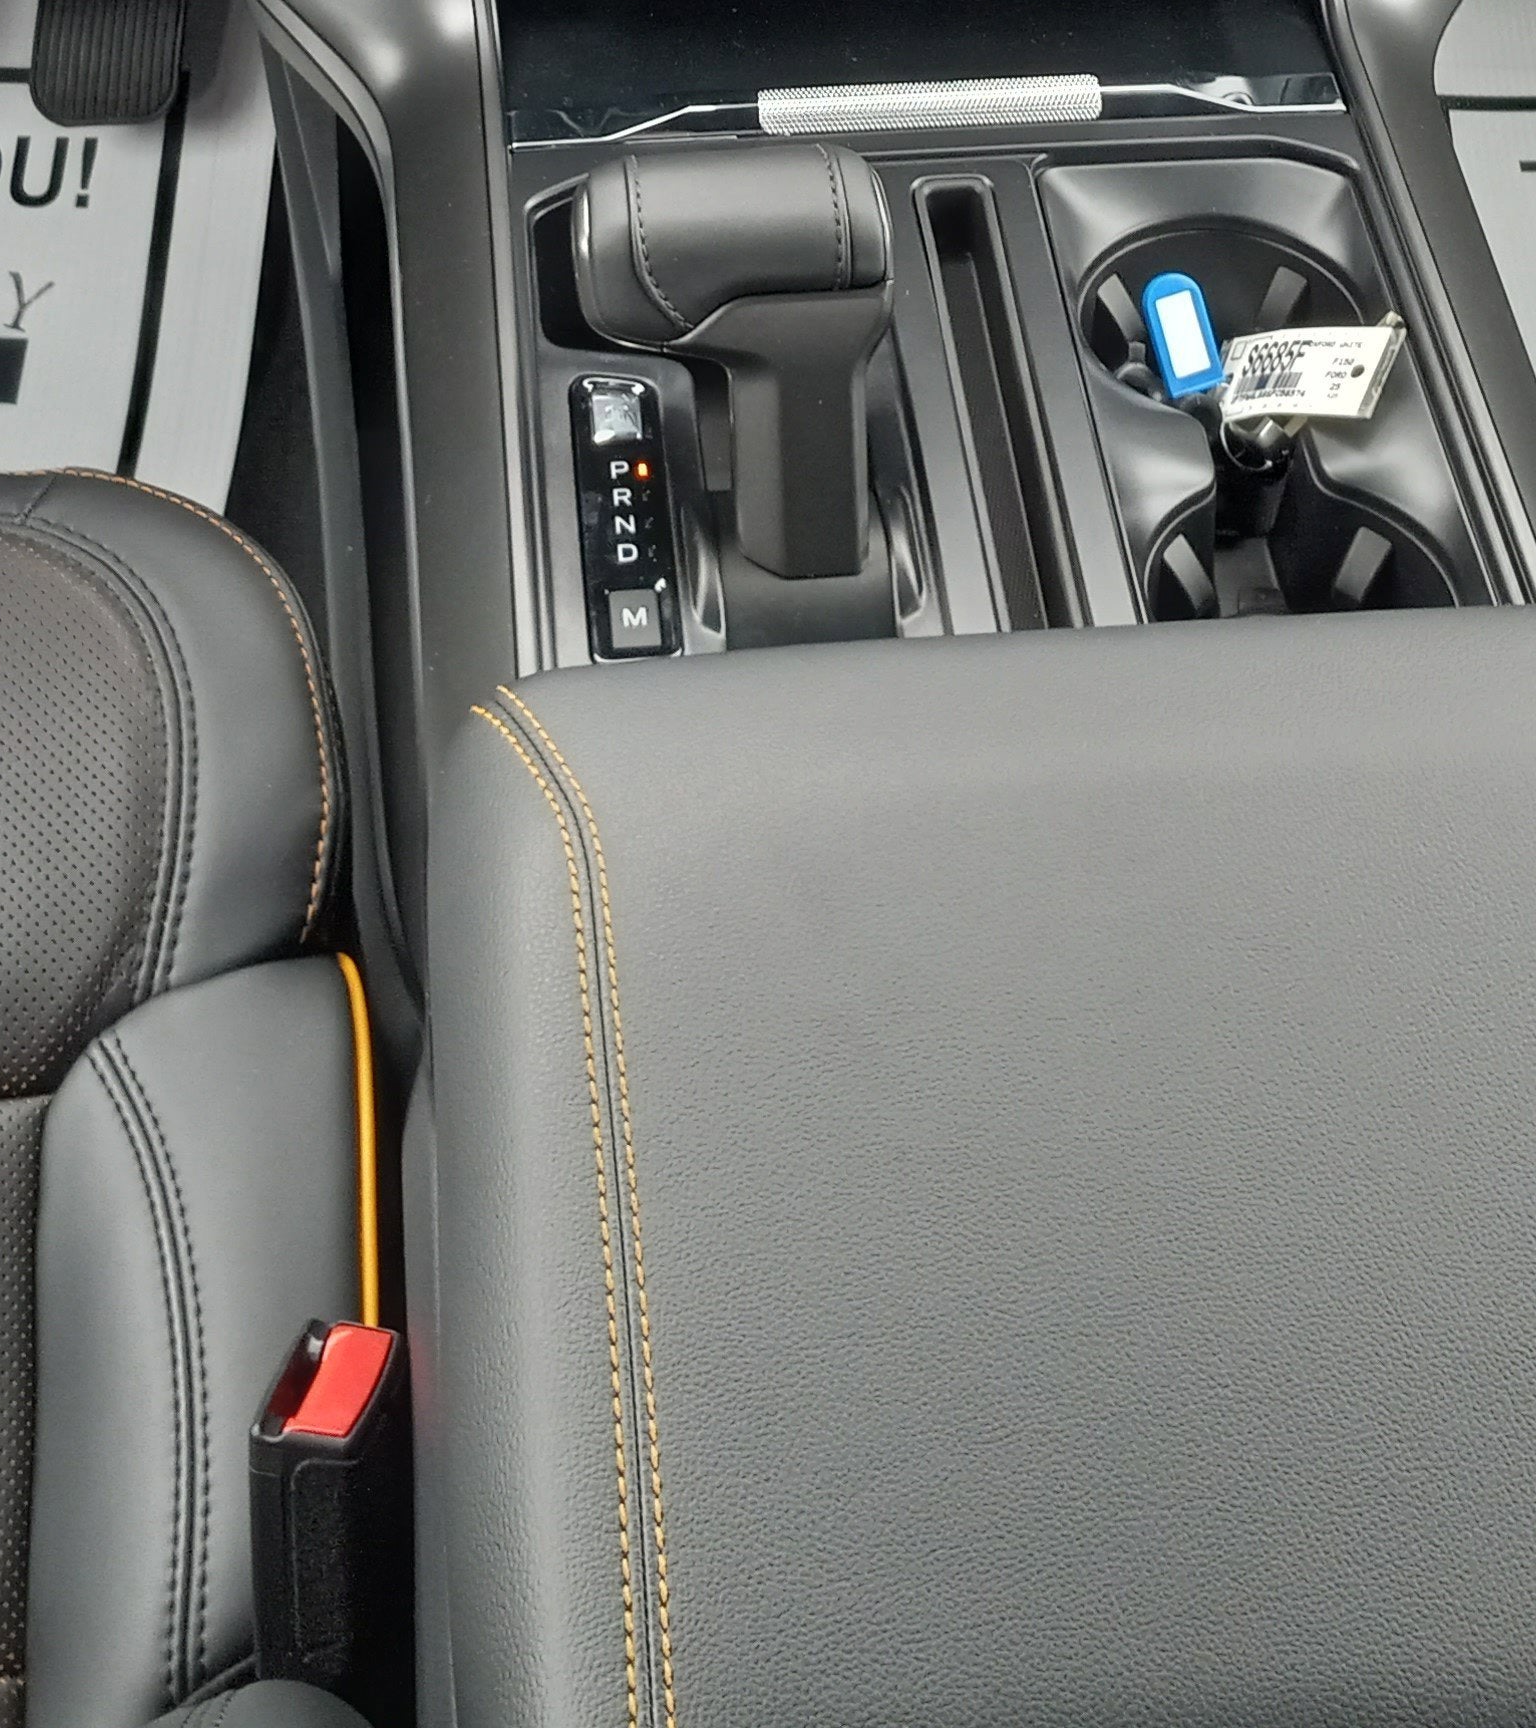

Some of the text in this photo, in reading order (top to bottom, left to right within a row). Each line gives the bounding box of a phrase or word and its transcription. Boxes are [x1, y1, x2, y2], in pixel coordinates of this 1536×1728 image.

[609, 460, 630, 480] P
[611, 487, 633, 507] R
[613, 514, 637, 535] N
[616, 542, 640, 563] D
[620, 605, 648, 628] M
